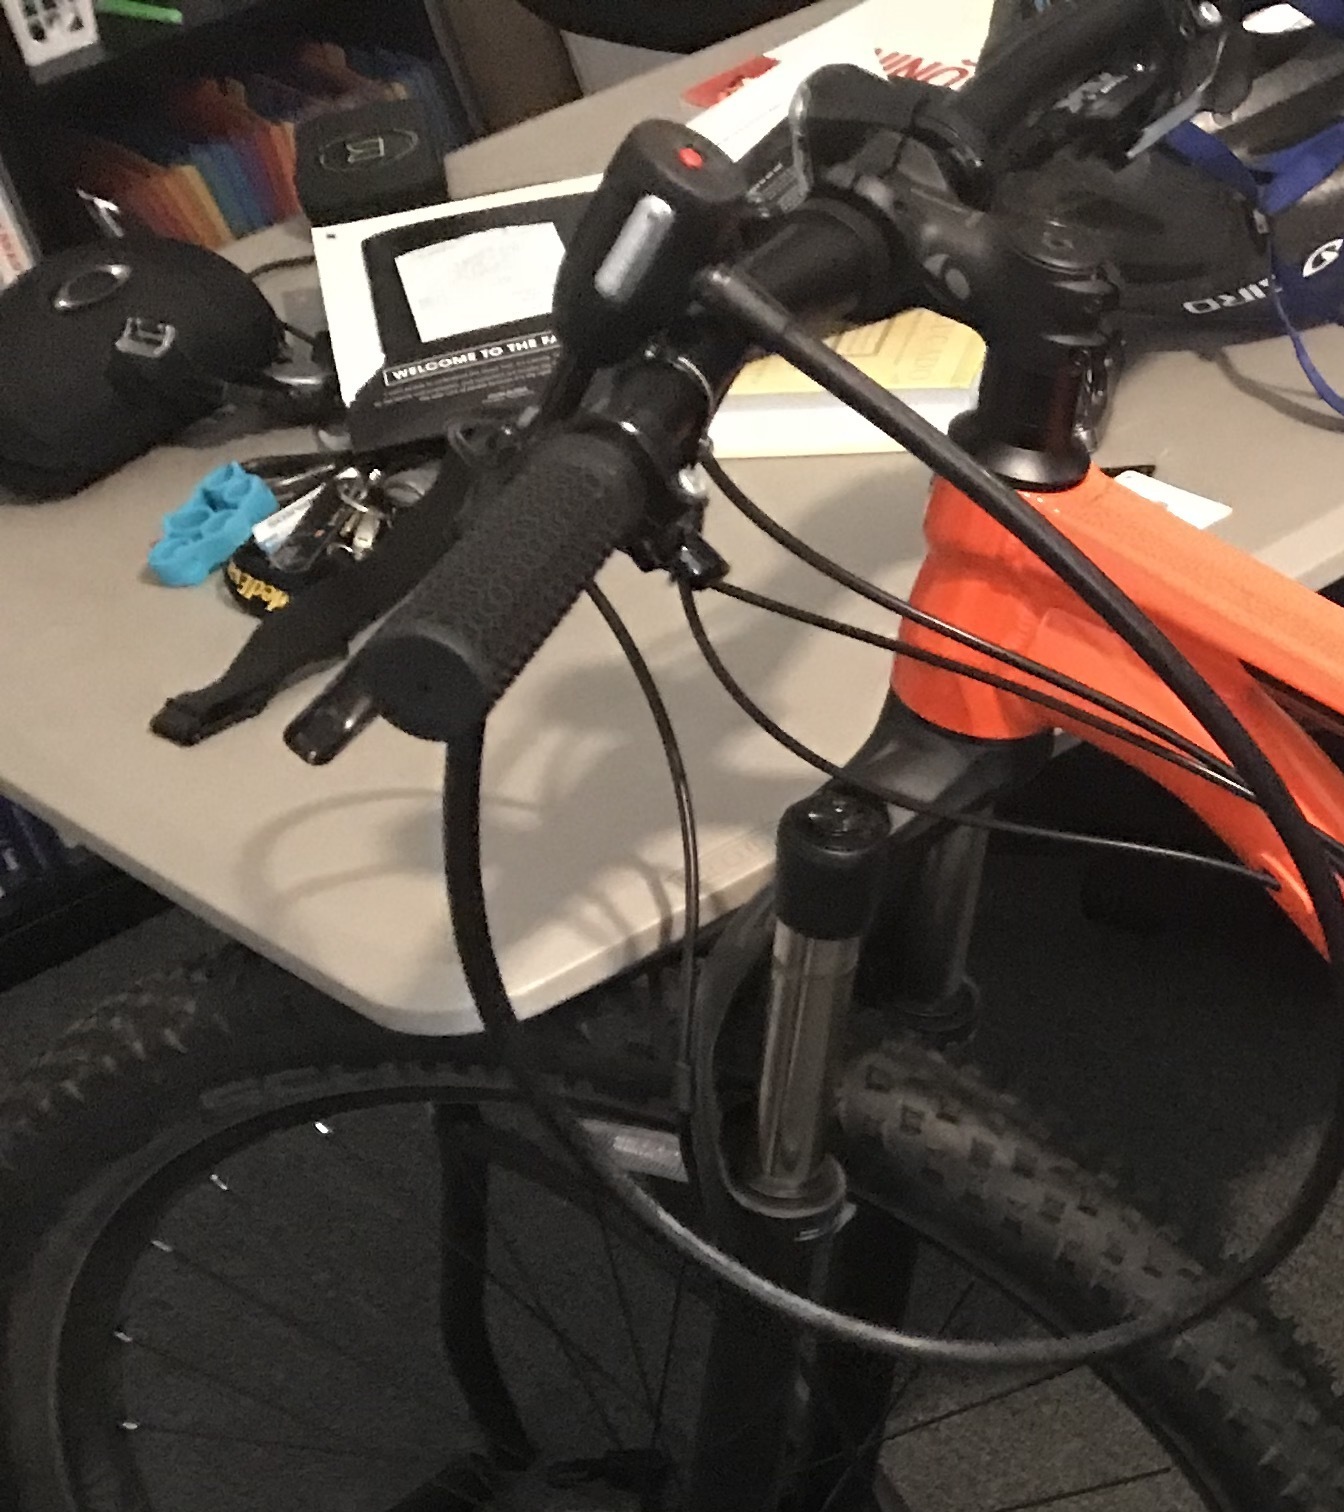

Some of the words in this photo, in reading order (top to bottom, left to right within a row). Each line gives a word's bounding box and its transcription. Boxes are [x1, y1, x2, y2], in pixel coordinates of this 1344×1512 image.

[392, 352, 476, 380] WELCOME
[480, 347, 504, 360] TO
[506, 338, 537, 354] THE
[541, 333, 558, 347] FA
